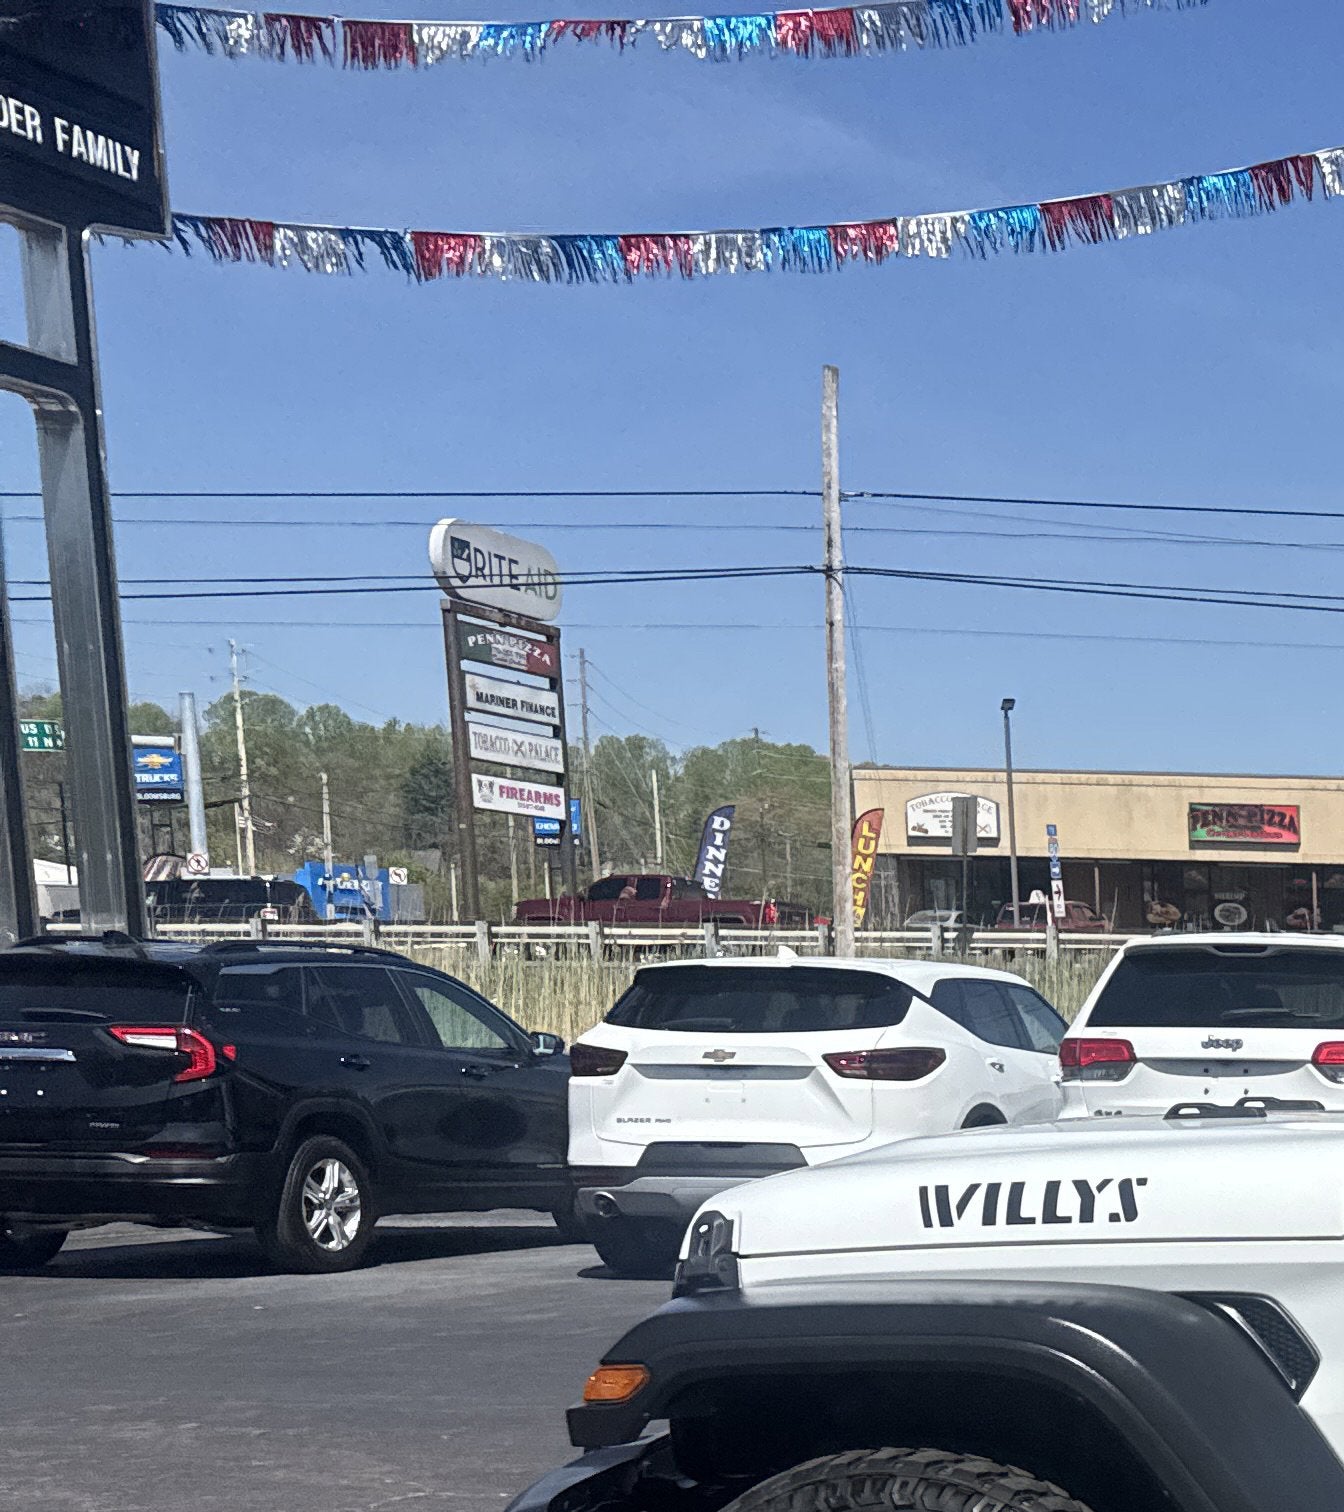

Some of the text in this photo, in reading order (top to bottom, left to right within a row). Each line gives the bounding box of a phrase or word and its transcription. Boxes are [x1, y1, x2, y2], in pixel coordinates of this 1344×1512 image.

[54, 116, 140, 182] FAMILY
[473, 546, 558, 601] RITE AID
[475, 691, 557, 719] MARINER FINANCE
[472, 731, 560, 765] TOBACCO PALACE
[134, 773, 178, 783] TRUCKS
[498, 784, 561, 808] FIREARMS
[701, 815, 731, 900] DINNE
[1201, 1035, 1243, 1052] Jeep
[919, 1177, 1148, 1228] WILLYS
